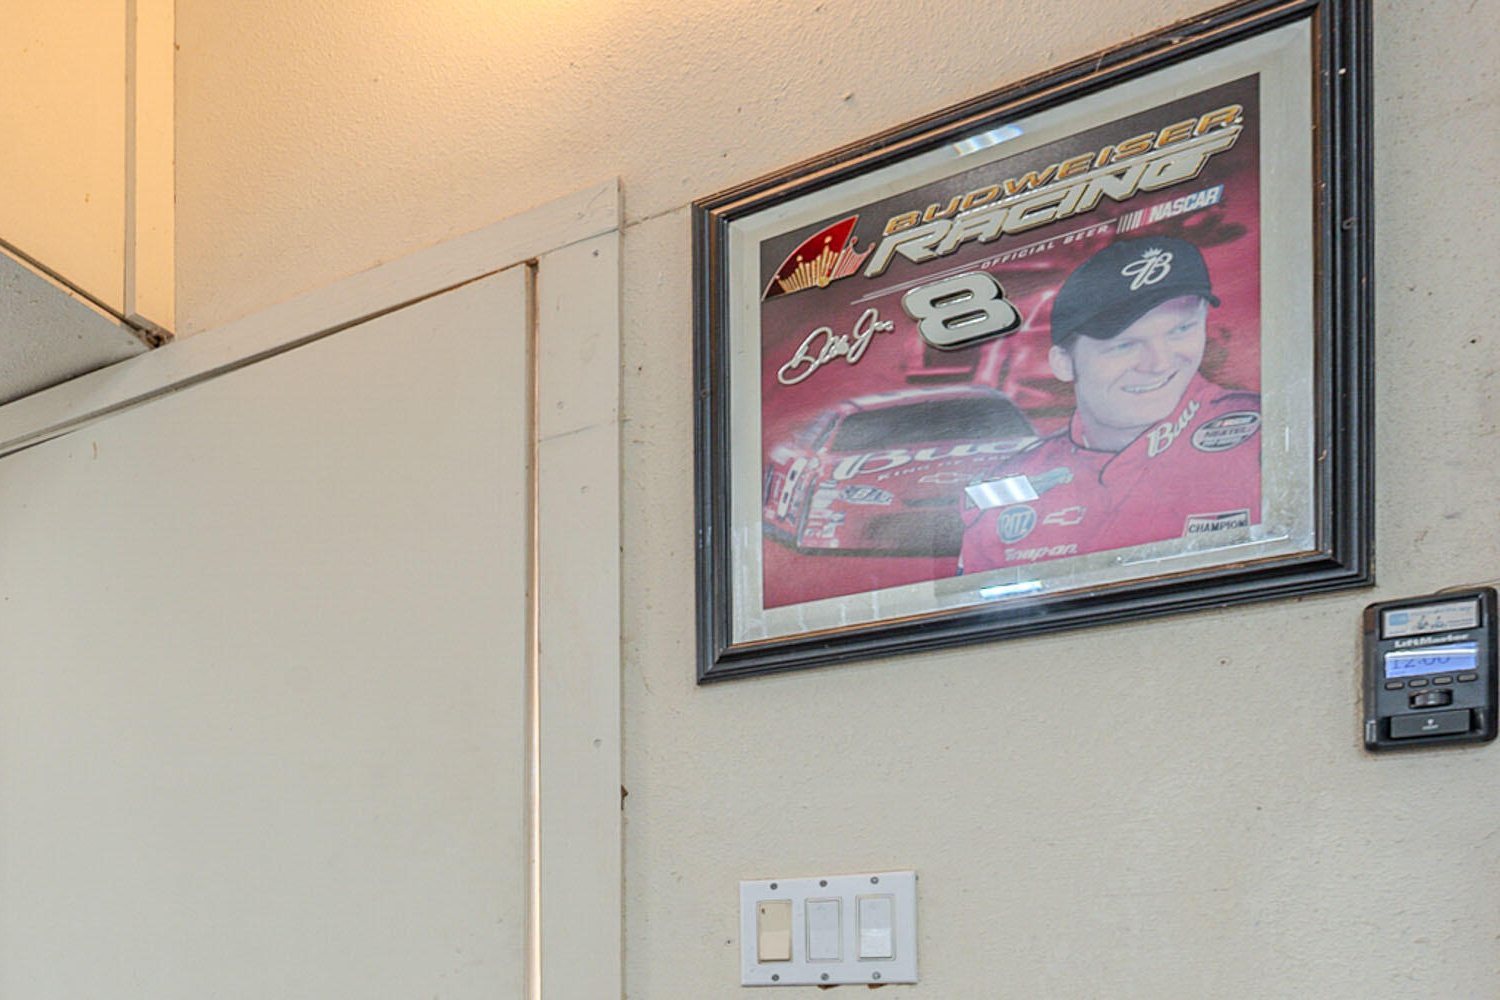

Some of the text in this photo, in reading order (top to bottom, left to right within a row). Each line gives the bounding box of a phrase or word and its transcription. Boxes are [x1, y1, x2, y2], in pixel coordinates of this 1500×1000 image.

[864, 124, 1244, 278] RACING
[884, 104, 1244, 236] BUDWEISER
[981, 187, 1219, 270] OFFICIAL BEER NASCAR
[902, 270, 1022, 350] 8
[1188, 515, 1248, 534] CHAMPION
